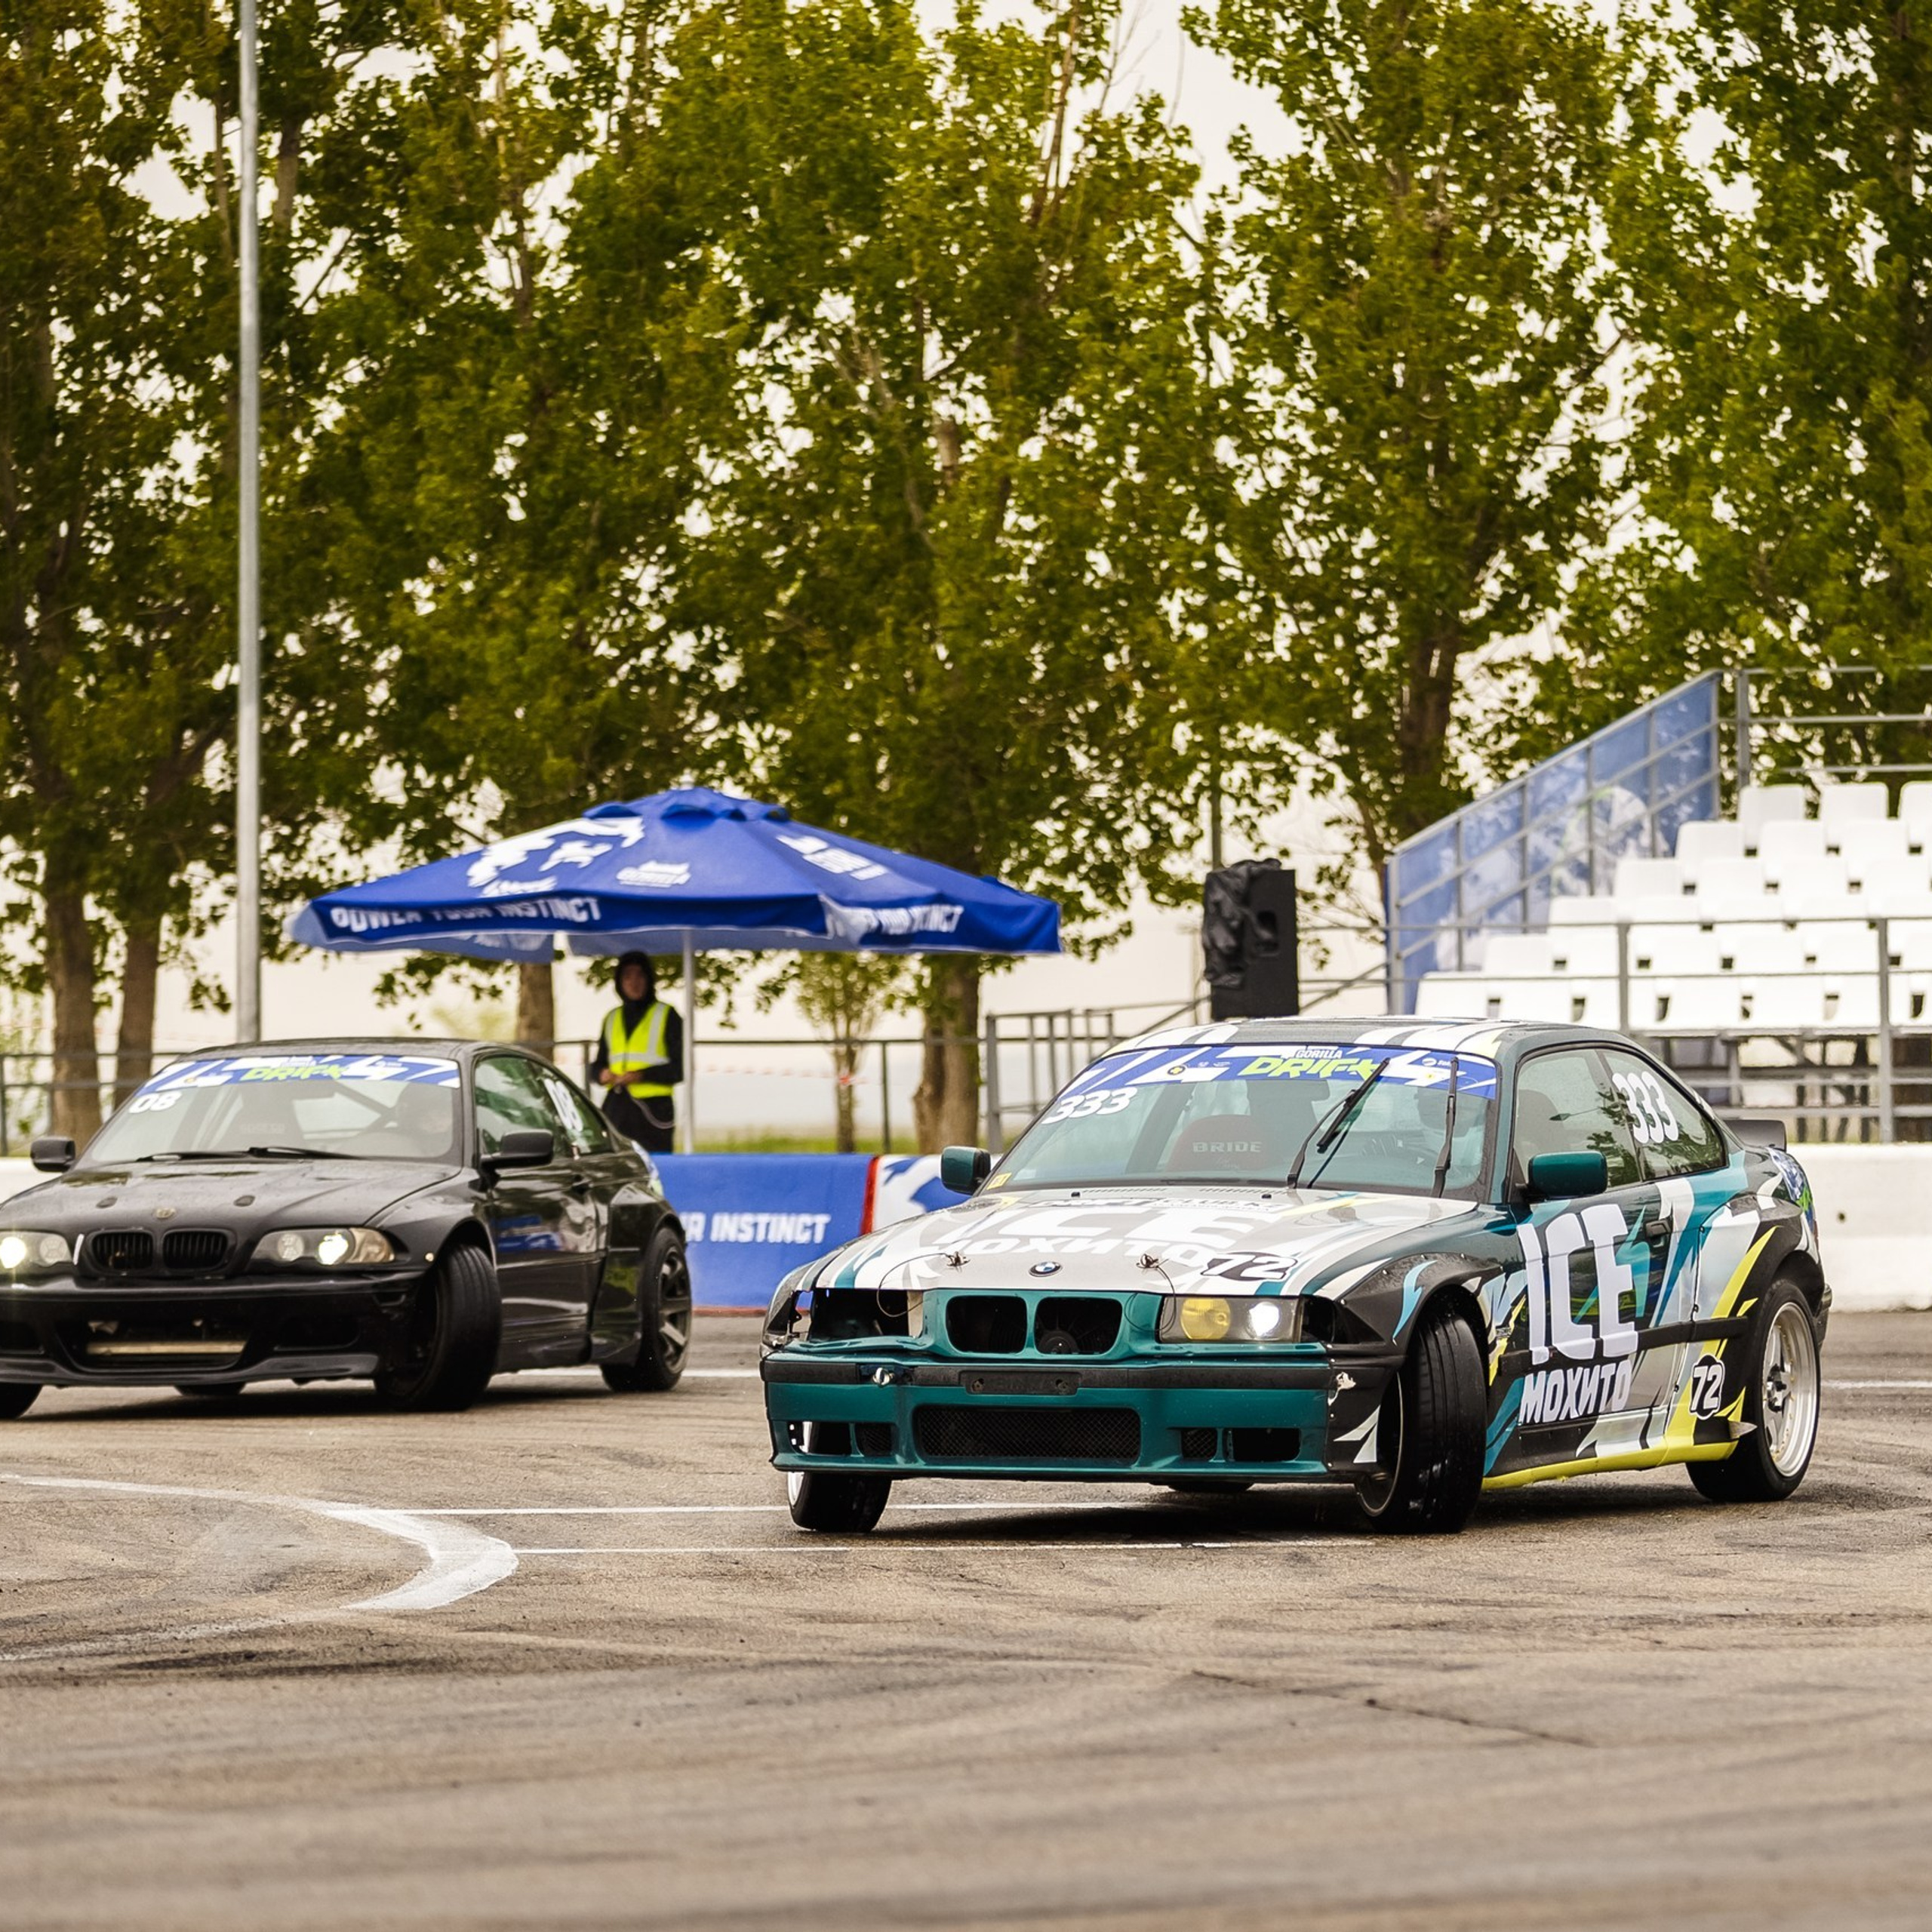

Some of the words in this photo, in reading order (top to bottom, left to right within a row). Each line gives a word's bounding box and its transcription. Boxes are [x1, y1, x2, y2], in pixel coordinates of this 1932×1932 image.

[1295, 1050, 1343, 1060] GORILLA
[128, 1091, 182, 1113] 08
[1041, 1087, 1137, 1124] 333
[1612, 1072, 1679, 1144] 333
[1192, 1141, 1262, 1153] BRIDE
[710, 1212, 831, 1244] INSTINCT
[930, 1208, 1279, 1250] ICE
[1201, 1253, 1298, 1281] 72
[1517, 1204, 1638, 1365] ICE
[1691, 1364, 1721, 1412] 72
